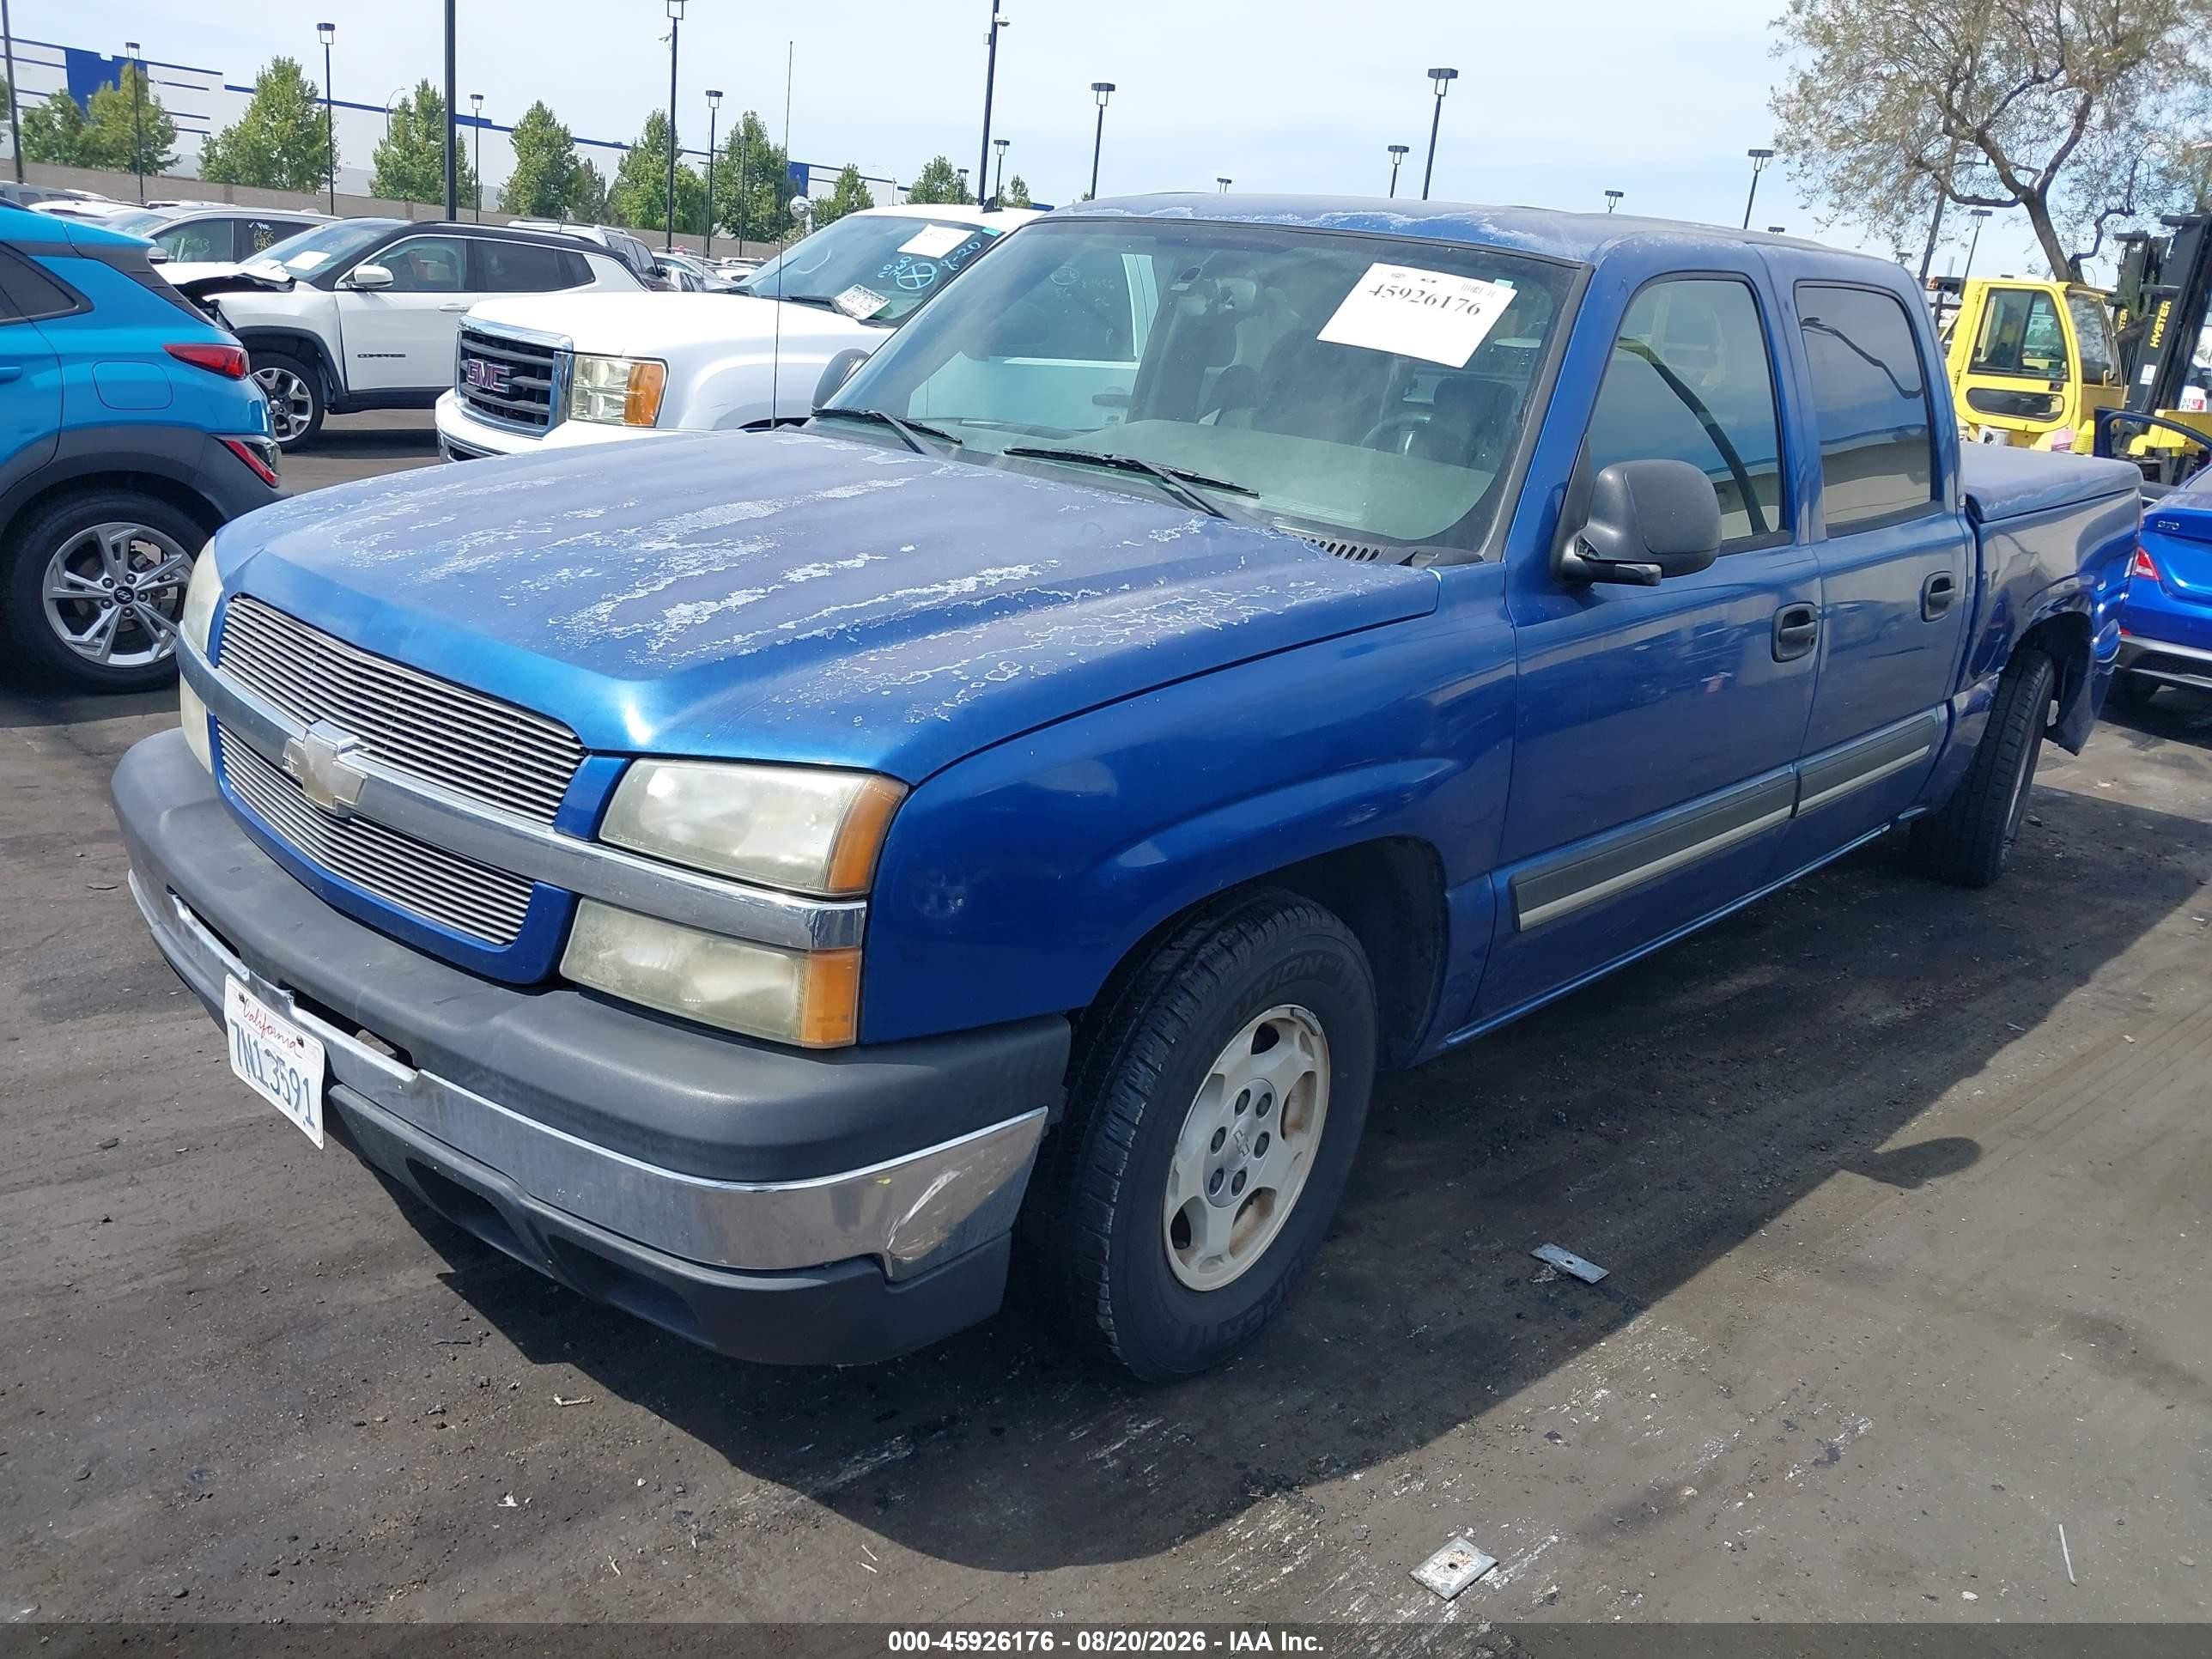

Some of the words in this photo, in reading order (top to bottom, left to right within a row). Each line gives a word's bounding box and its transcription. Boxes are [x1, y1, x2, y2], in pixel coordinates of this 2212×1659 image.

[940, 241, 982, 271] 8-20
[1369, 283, 1483, 316] 45926176
[2118, 308, 2129, 331] STER
[2148, 301, 2172, 349] HYSTER
[466, 358, 511, 394] GMC
[242, 998, 303, 1059] California
